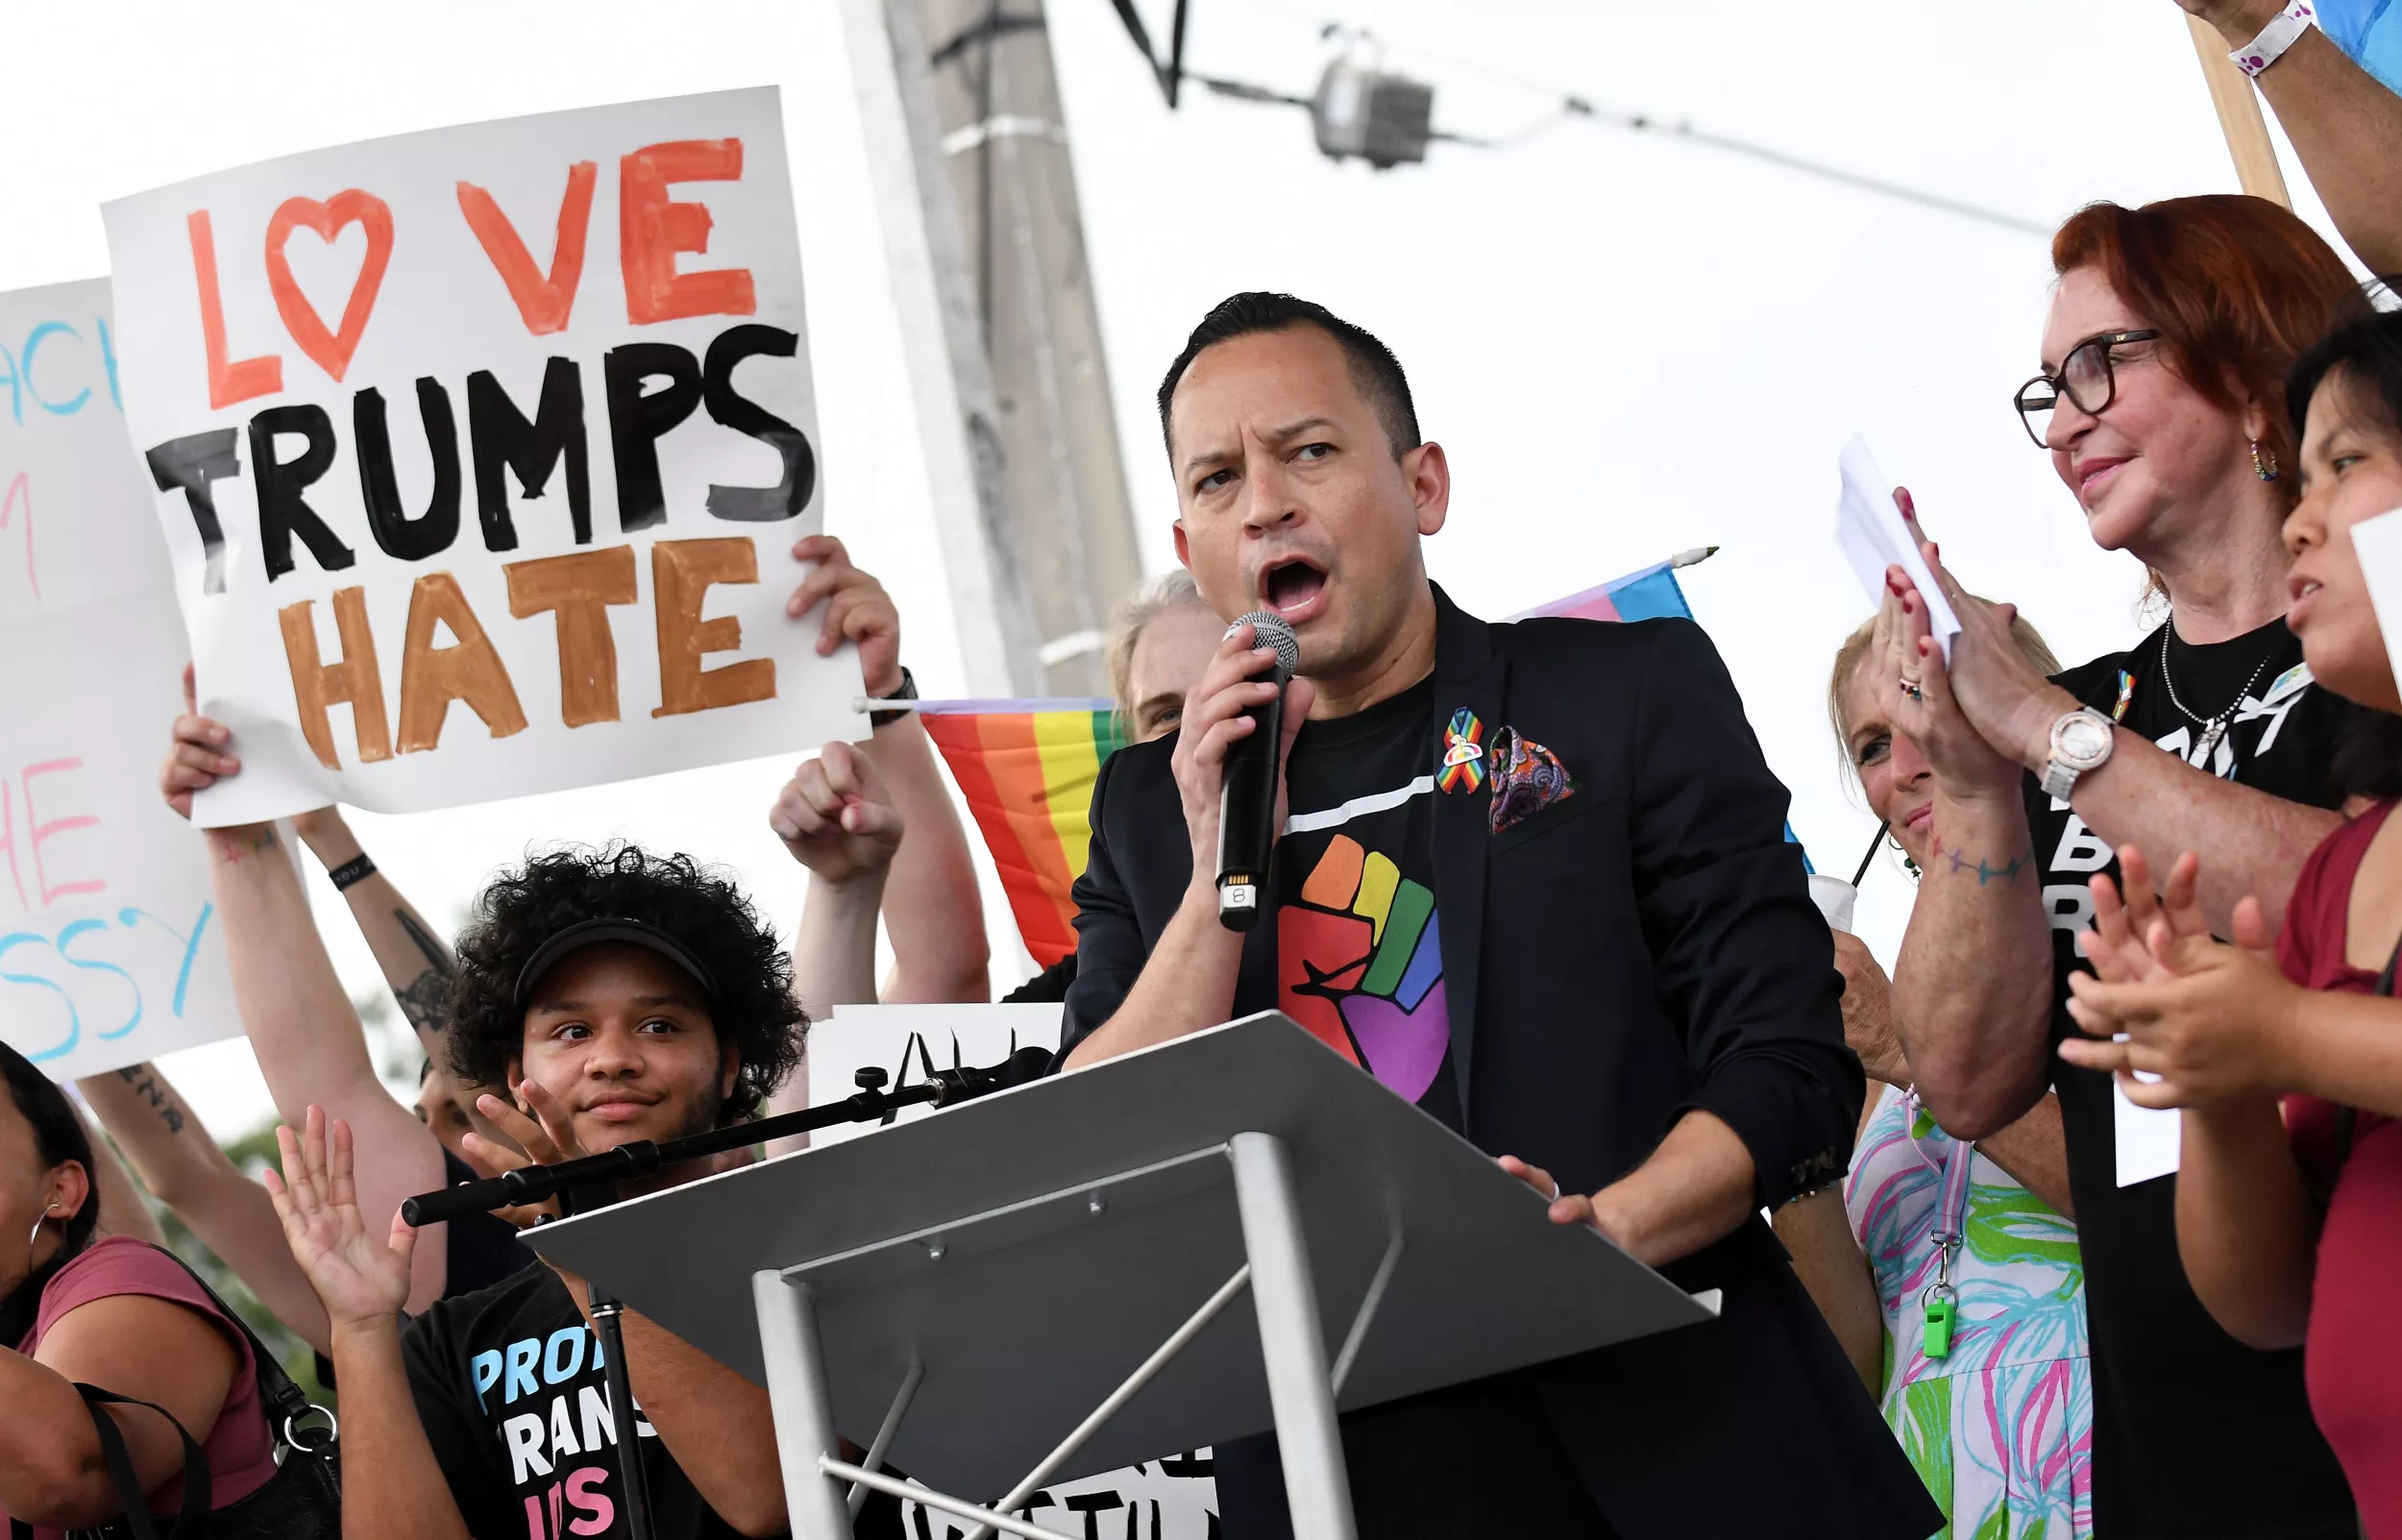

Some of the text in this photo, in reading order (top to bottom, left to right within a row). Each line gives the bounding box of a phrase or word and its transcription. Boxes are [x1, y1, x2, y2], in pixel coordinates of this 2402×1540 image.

[146, 324, 816, 594] TRUMPS
[279, 536, 777, 770] HATE
[1233, 888, 1246, 903] 8
